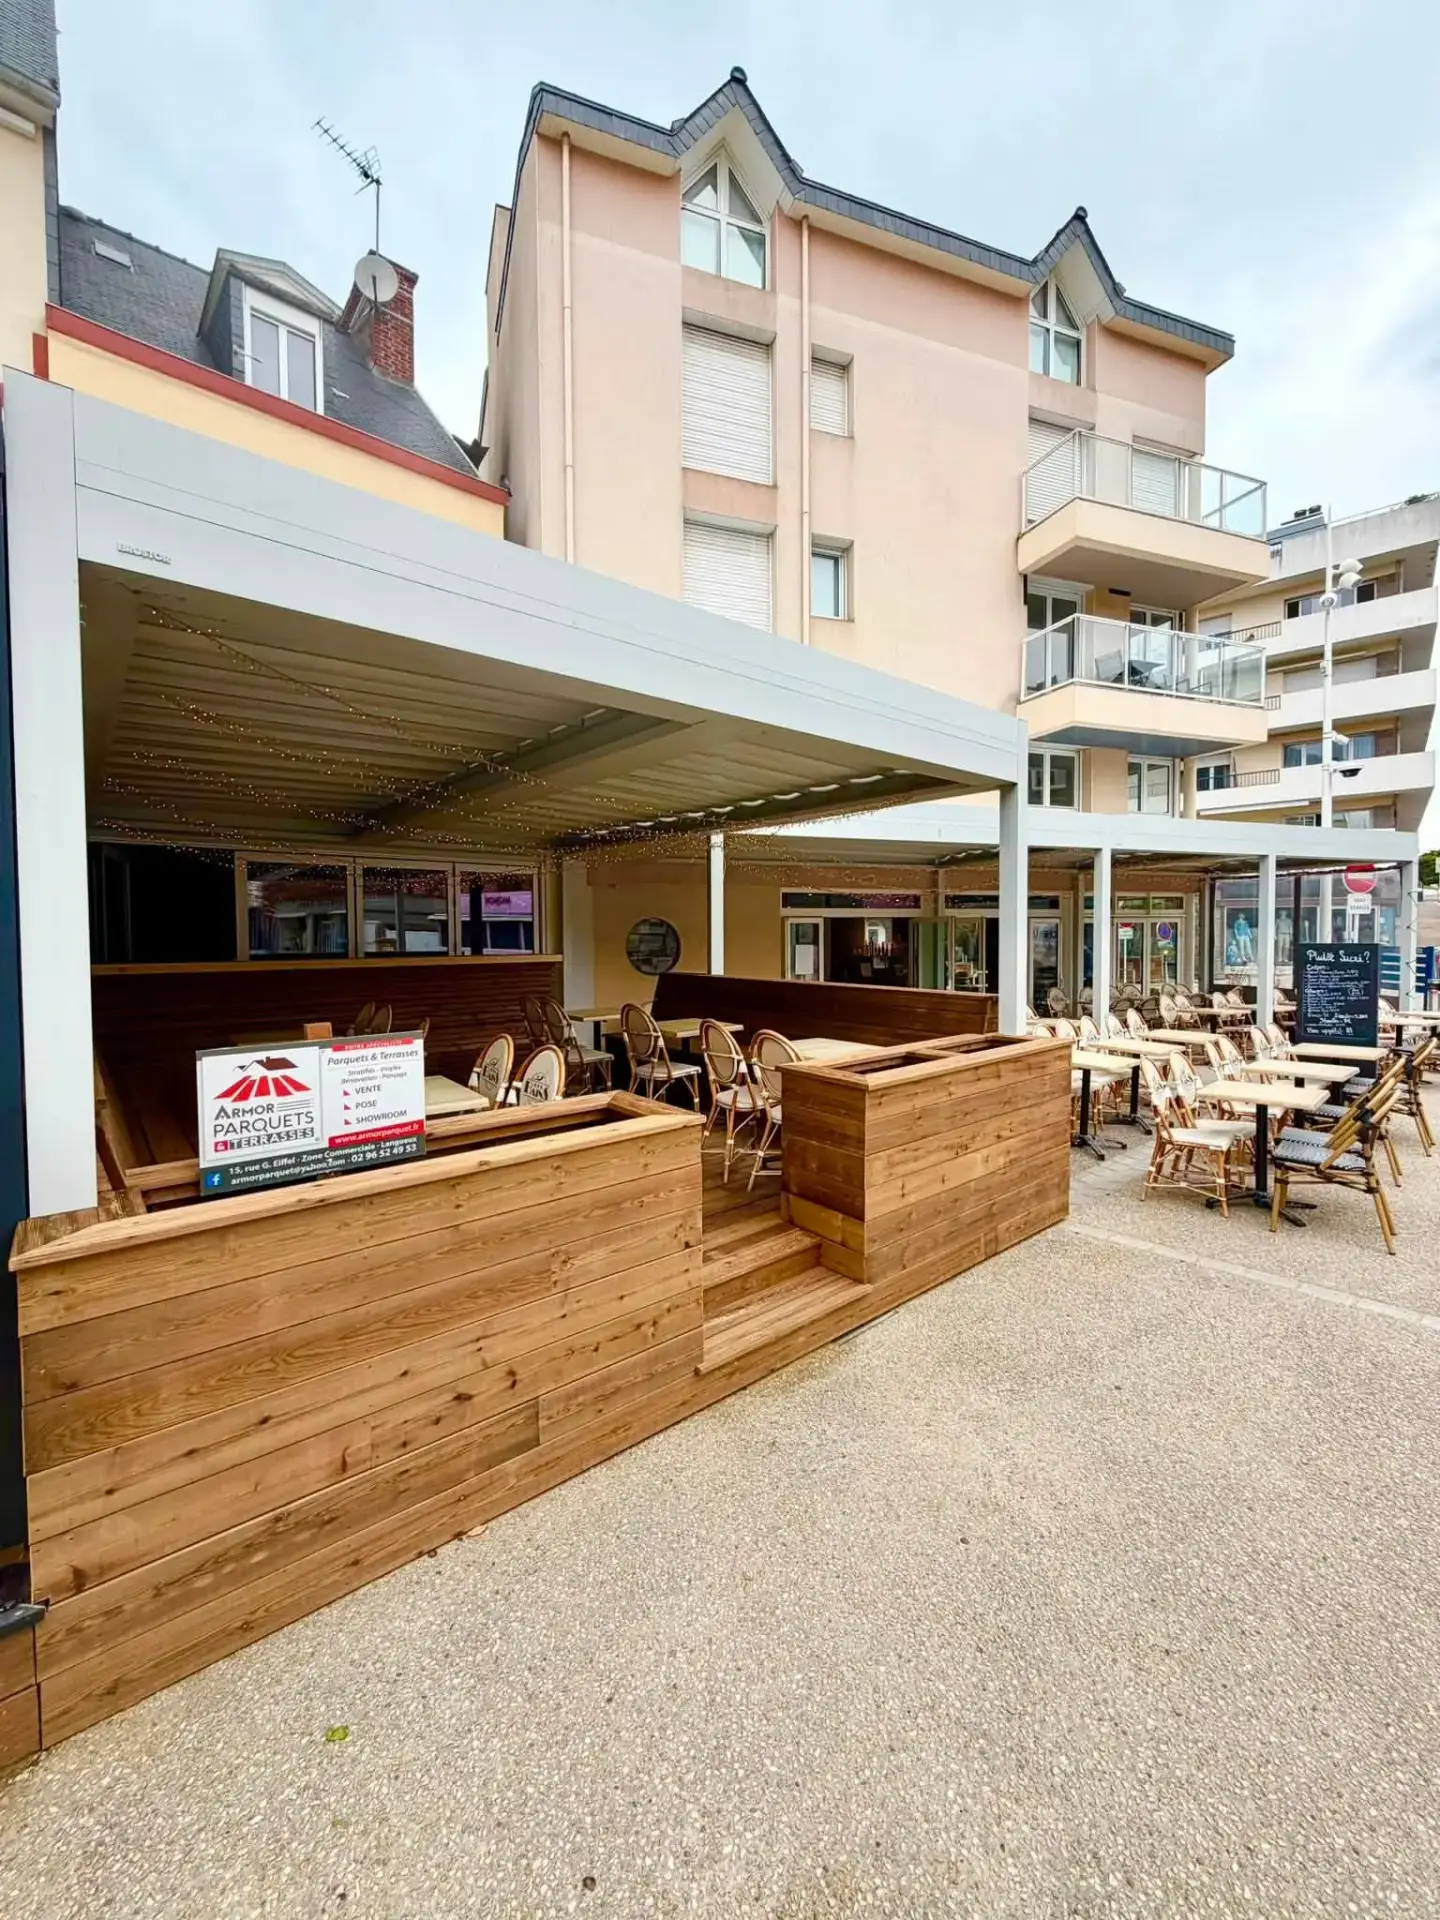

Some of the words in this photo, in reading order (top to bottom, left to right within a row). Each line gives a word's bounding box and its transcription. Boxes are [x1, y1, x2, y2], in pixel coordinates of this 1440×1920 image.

[327, 1054, 369, 1066] Parquets
[370, 1052, 378, 1061] &
[380, 1049, 418, 1060] Terrasses
[354, 1084, 382, 1095] VENTE
[214, 1103, 275, 1121] ARMOR
[355, 1100, 378, 1110] POSE
[213, 1111, 315, 1138] PARQUETS
[355, 1110, 408, 1124] SHOWROOM
[230, 1128, 313, 1149] TERRASSES
[334, 1122, 420, 1144] www.armorparquet.fr
[229, 1166, 243, 1175] 15,
[244, 1164, 260, 1172] rue
[261, 1161, 272, 1170] G.
[273, 1156, 296, 1168] Eiffel
[301, 1153, 323, 1163] Zone
[324, 1143, 376, 1158] Commerciale
[381, 1137, 418, 1148] Langueux
[351, 1154, 364, 1163] 02
[365, 1150, 377, 1160] 96
[379, 1148, 391, 1158] 52
[392, 1146, 404, 1155] 49
[406, 1143, 417, 1153] 53
